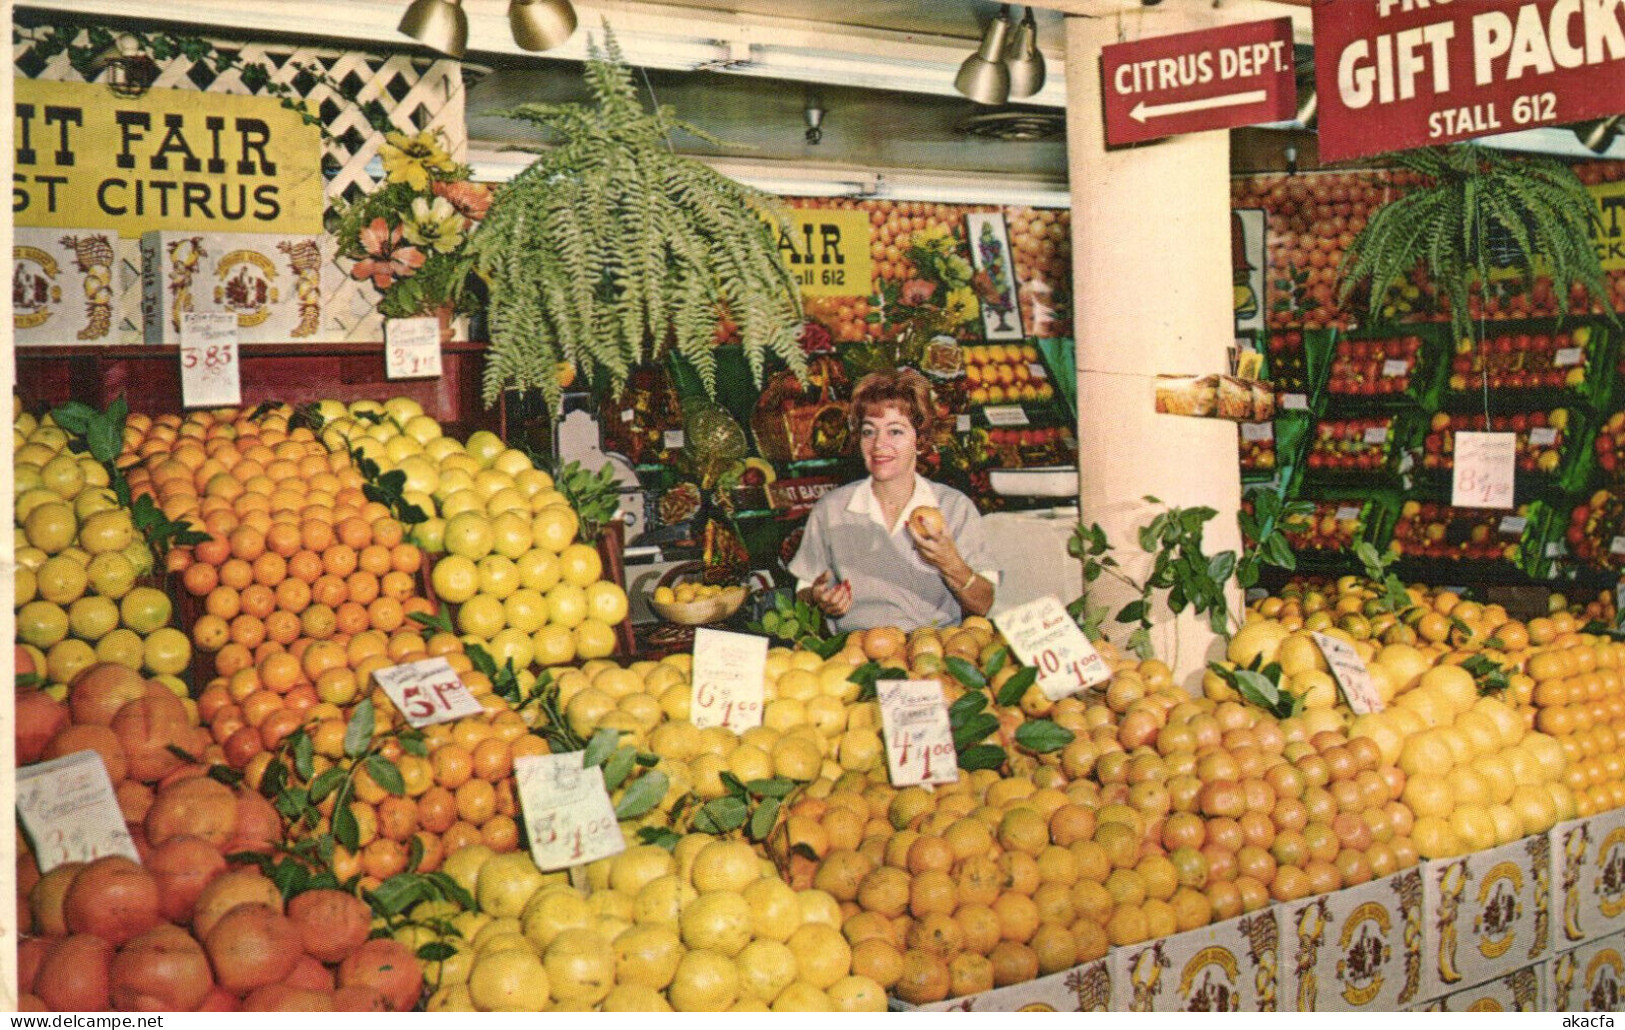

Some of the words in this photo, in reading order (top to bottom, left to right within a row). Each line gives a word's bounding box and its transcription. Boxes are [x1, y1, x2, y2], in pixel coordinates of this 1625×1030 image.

[1114, 51, 1214, 95] CITRUS
[1219, 40, 1289, 80] DEPT.
[1338, 21, 1455, 109] GIFT
[1429, 103, 1501, 138] STALL
[1512, 92, 1557, 124] 612
[15, 103, 83, 166] IT
[115, 110, 277, 176] FAIR
[97, 178, 281, 221] CITRUS
[776, 223, 845, 264] AIR
[822, 269, 846, 286] 612
[1033, 650, 1059, 680] 10
[403, 686, 436, 718] 5
[893, 731, 913, 767] 4
